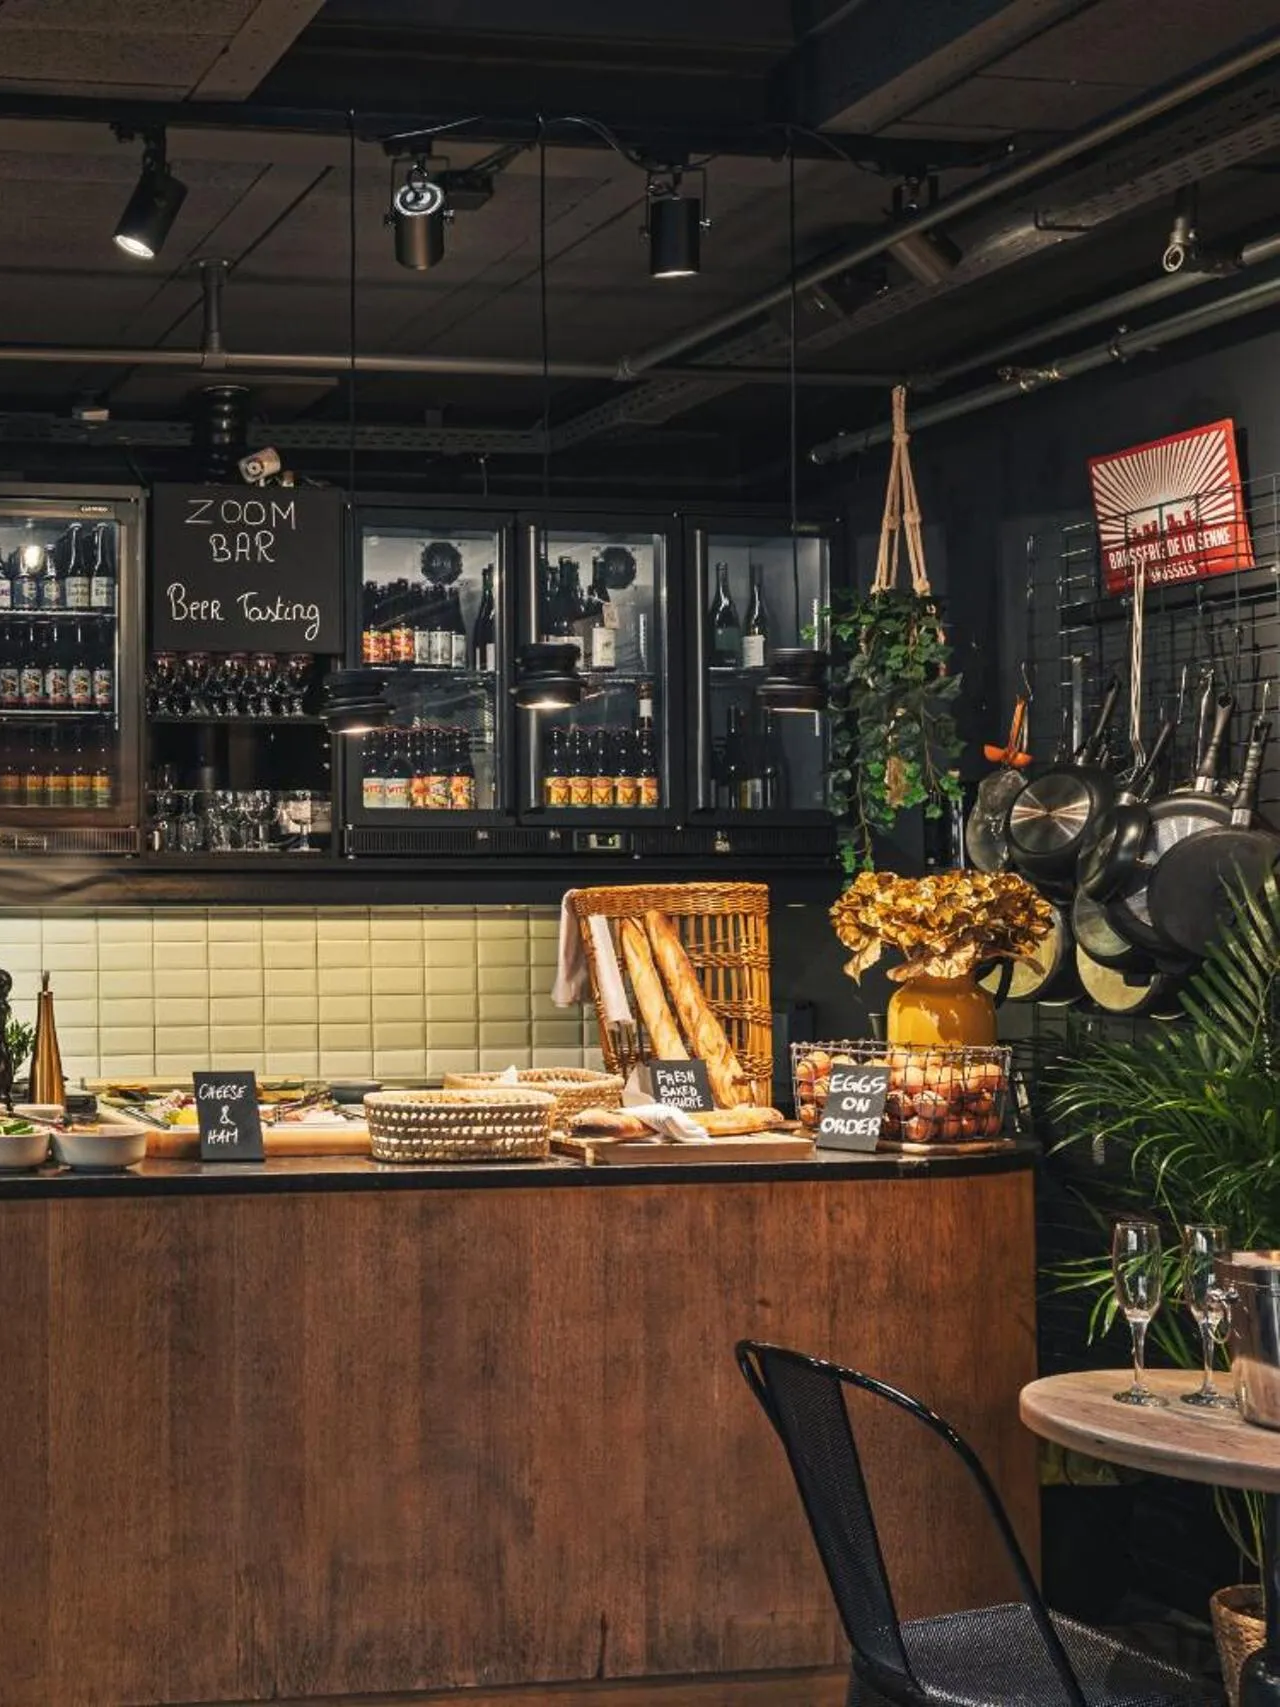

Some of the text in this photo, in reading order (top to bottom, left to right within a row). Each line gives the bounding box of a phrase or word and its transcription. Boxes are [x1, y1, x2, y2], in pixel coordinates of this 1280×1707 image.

[184, 499, 296, 530] ZOOM
[209, 530, 275, 563] BAR
[1167, 536, 1181, 557] DE
[1182, 534, 1196, 553] LA
[236, 591, 320, 641] Tasting
[656, 1069, 696, 1085] FRESH
[830, 1072, 888, 1095] EGGS
[198, 1083, 248, 1101] CHEESE
[660, 1084, 698, 1098] BAKED
[219, 1104, 237, 1126] &
[841, 1096, 872, 1113] ON
[207, 1127, 239, 1145] HAM
[821, 1116, 882, 1137] ORDER
